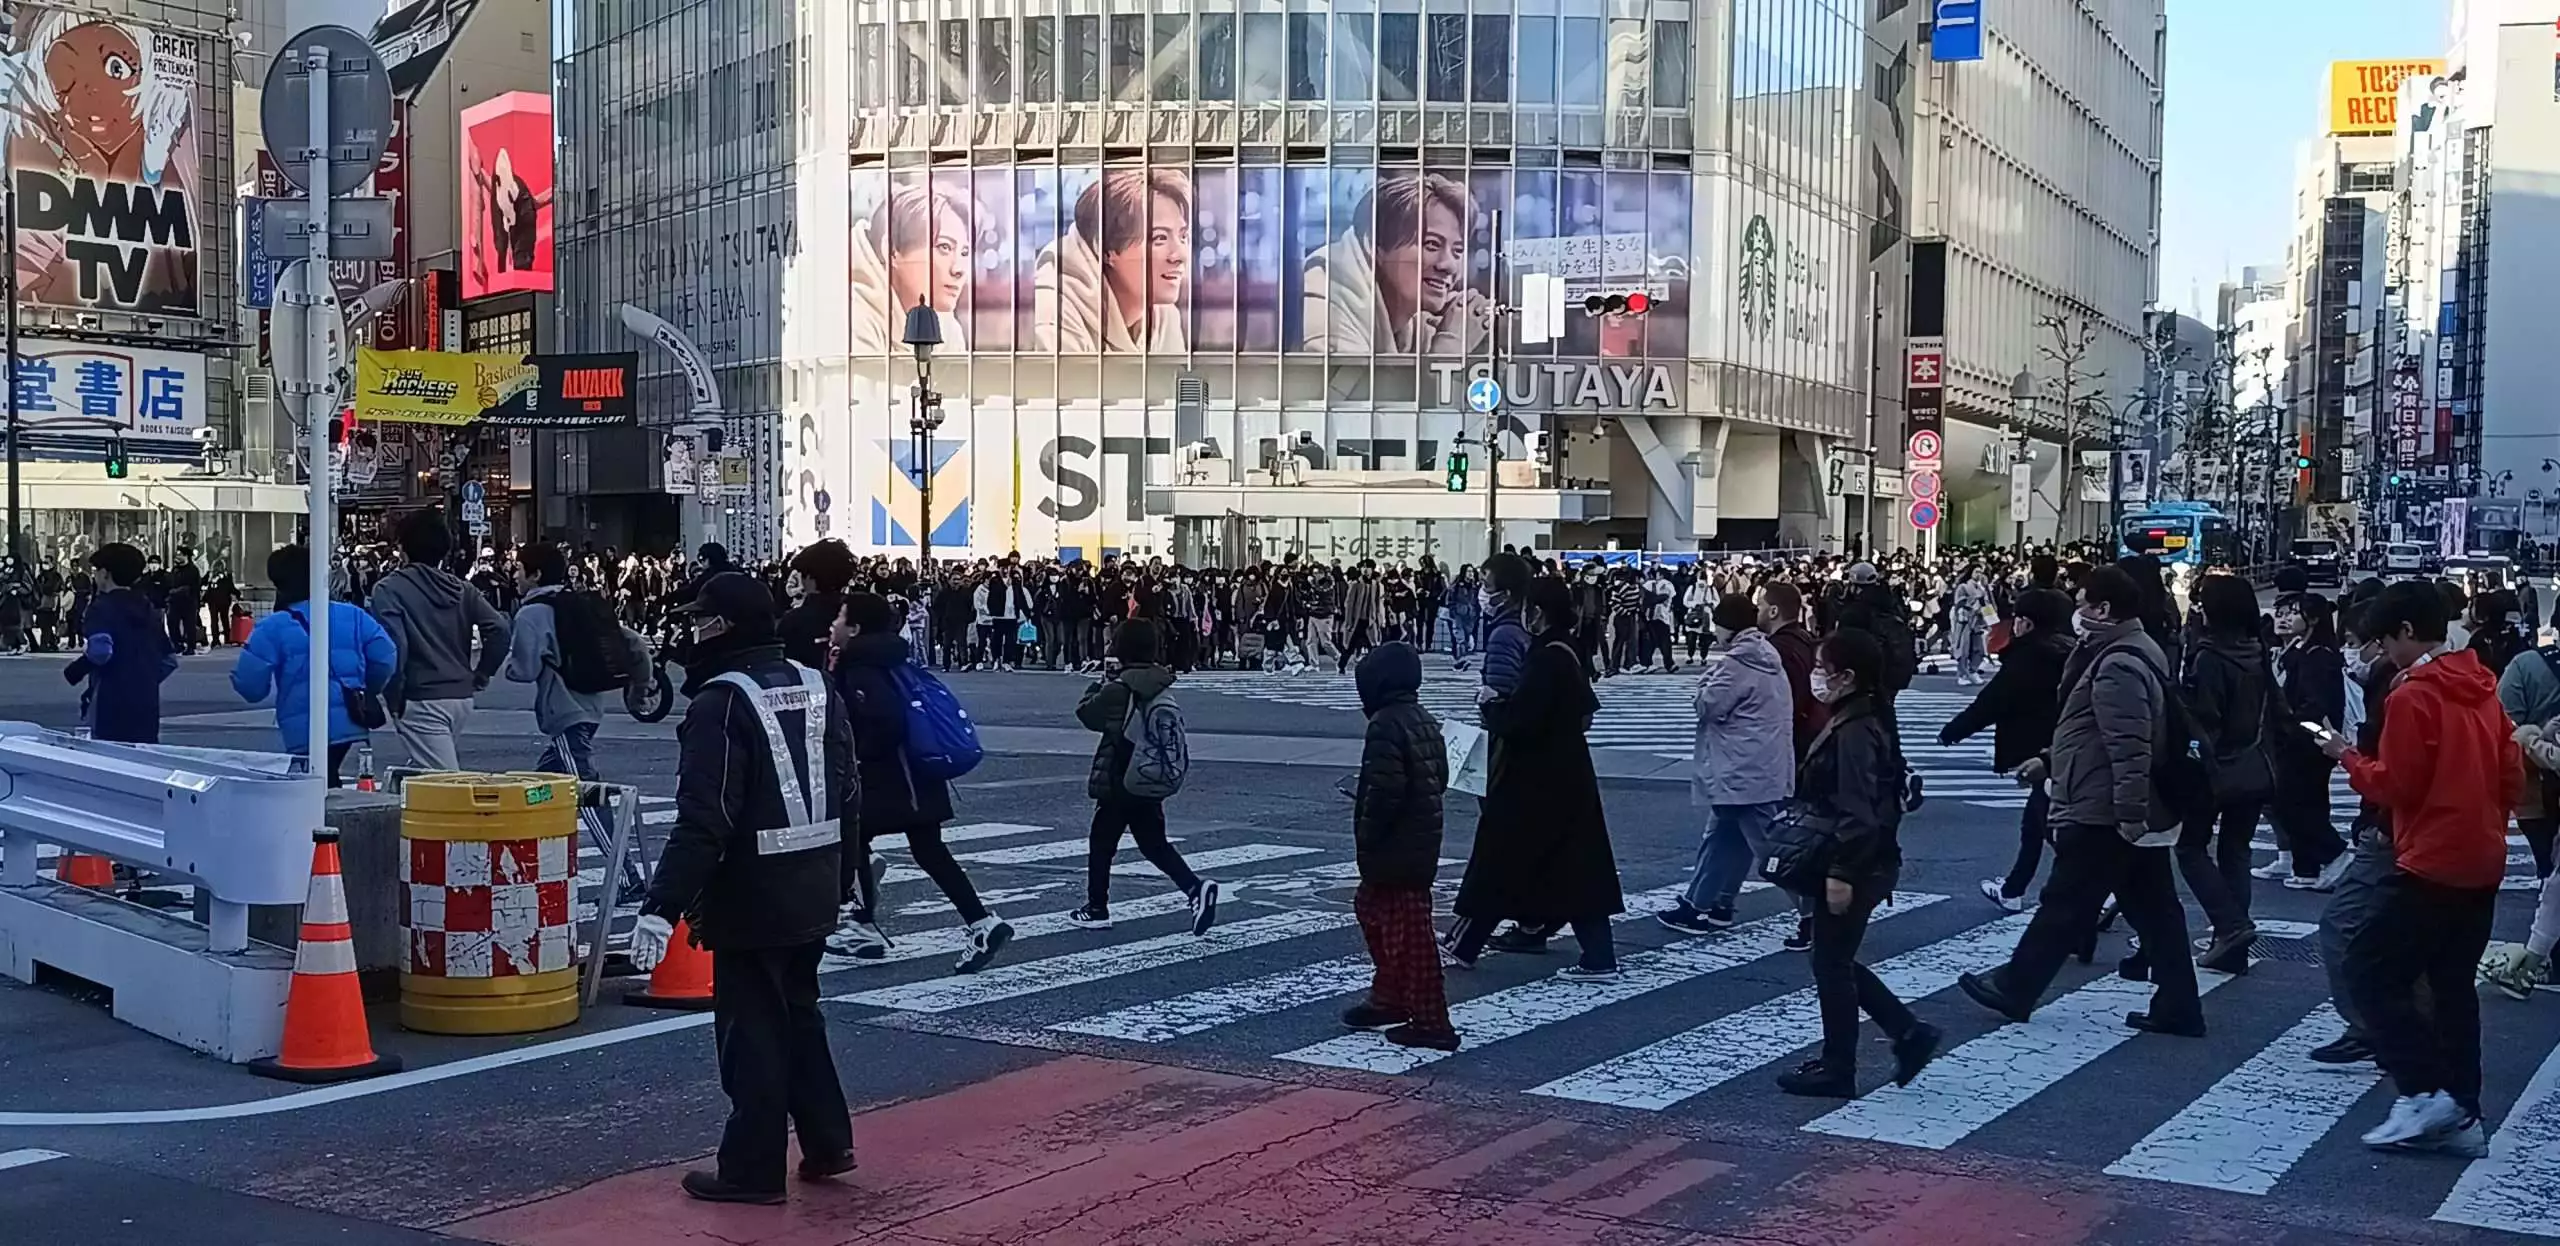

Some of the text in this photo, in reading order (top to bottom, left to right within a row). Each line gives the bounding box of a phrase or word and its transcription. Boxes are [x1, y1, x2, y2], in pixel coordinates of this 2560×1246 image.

[153, 35, 194, 59] GREAT
[154, 58, 194, 77] PRETENDER
[16, 169, 192, 249] DMM
[66, 240, 149, 304] TV
[639, 238, 712, 287] SHIBUYA
[562, 368, 624, 398] ALVARK
[1914, 357, 1938, 381] 本
[3, 359, 185, 421] 堂書店
[140, 424, 163, 434] BOOKS
